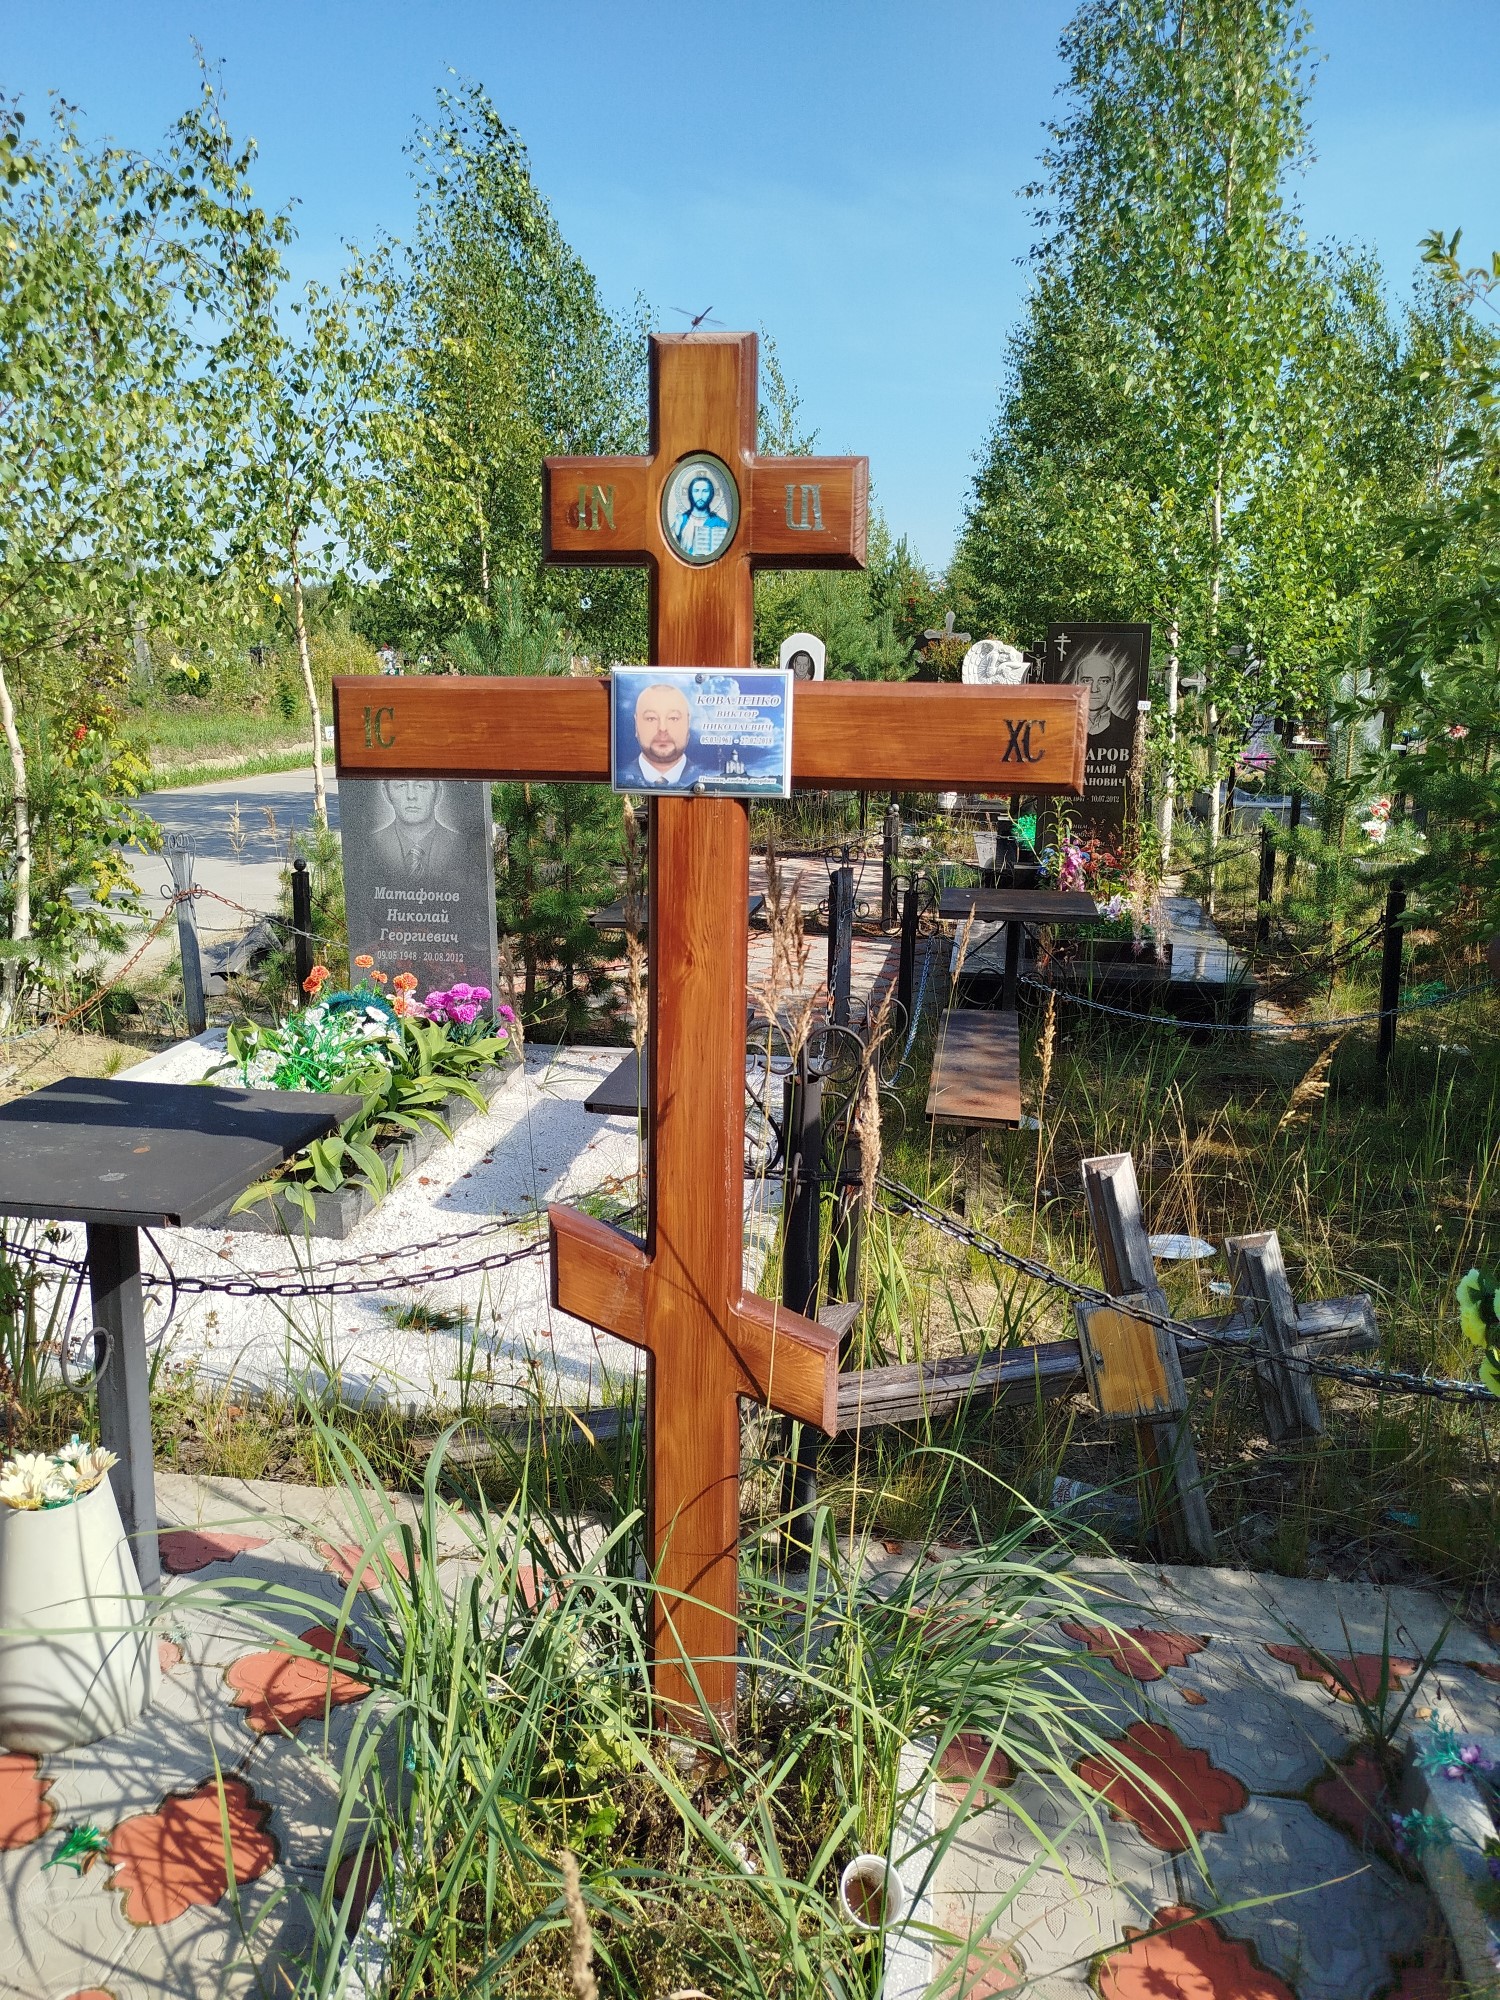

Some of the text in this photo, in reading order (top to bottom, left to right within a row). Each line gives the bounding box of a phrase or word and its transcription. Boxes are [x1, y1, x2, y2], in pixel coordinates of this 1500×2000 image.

[697, 695, 780, 706] КОВАЛЕНКО
[717, 710, 759, 718] ВИКТОР
[702, 723, 773, 732] НИКОЛАЕВИЧ
[1084, 748, 1130, 761] АРОВ
[1084, 764, 1117, 774] ИЛИЙ
[1082, 778, 1126, 787] АНОВИЧ
[373, 886, 460, 904] Матафонов
[386, 908, 450, 923] Николай
[379, 928, 460, 945] Георгиевич
[377, 950, 417, 961] 09.051948
[423, 952, 464, 962] 20.08.2012
